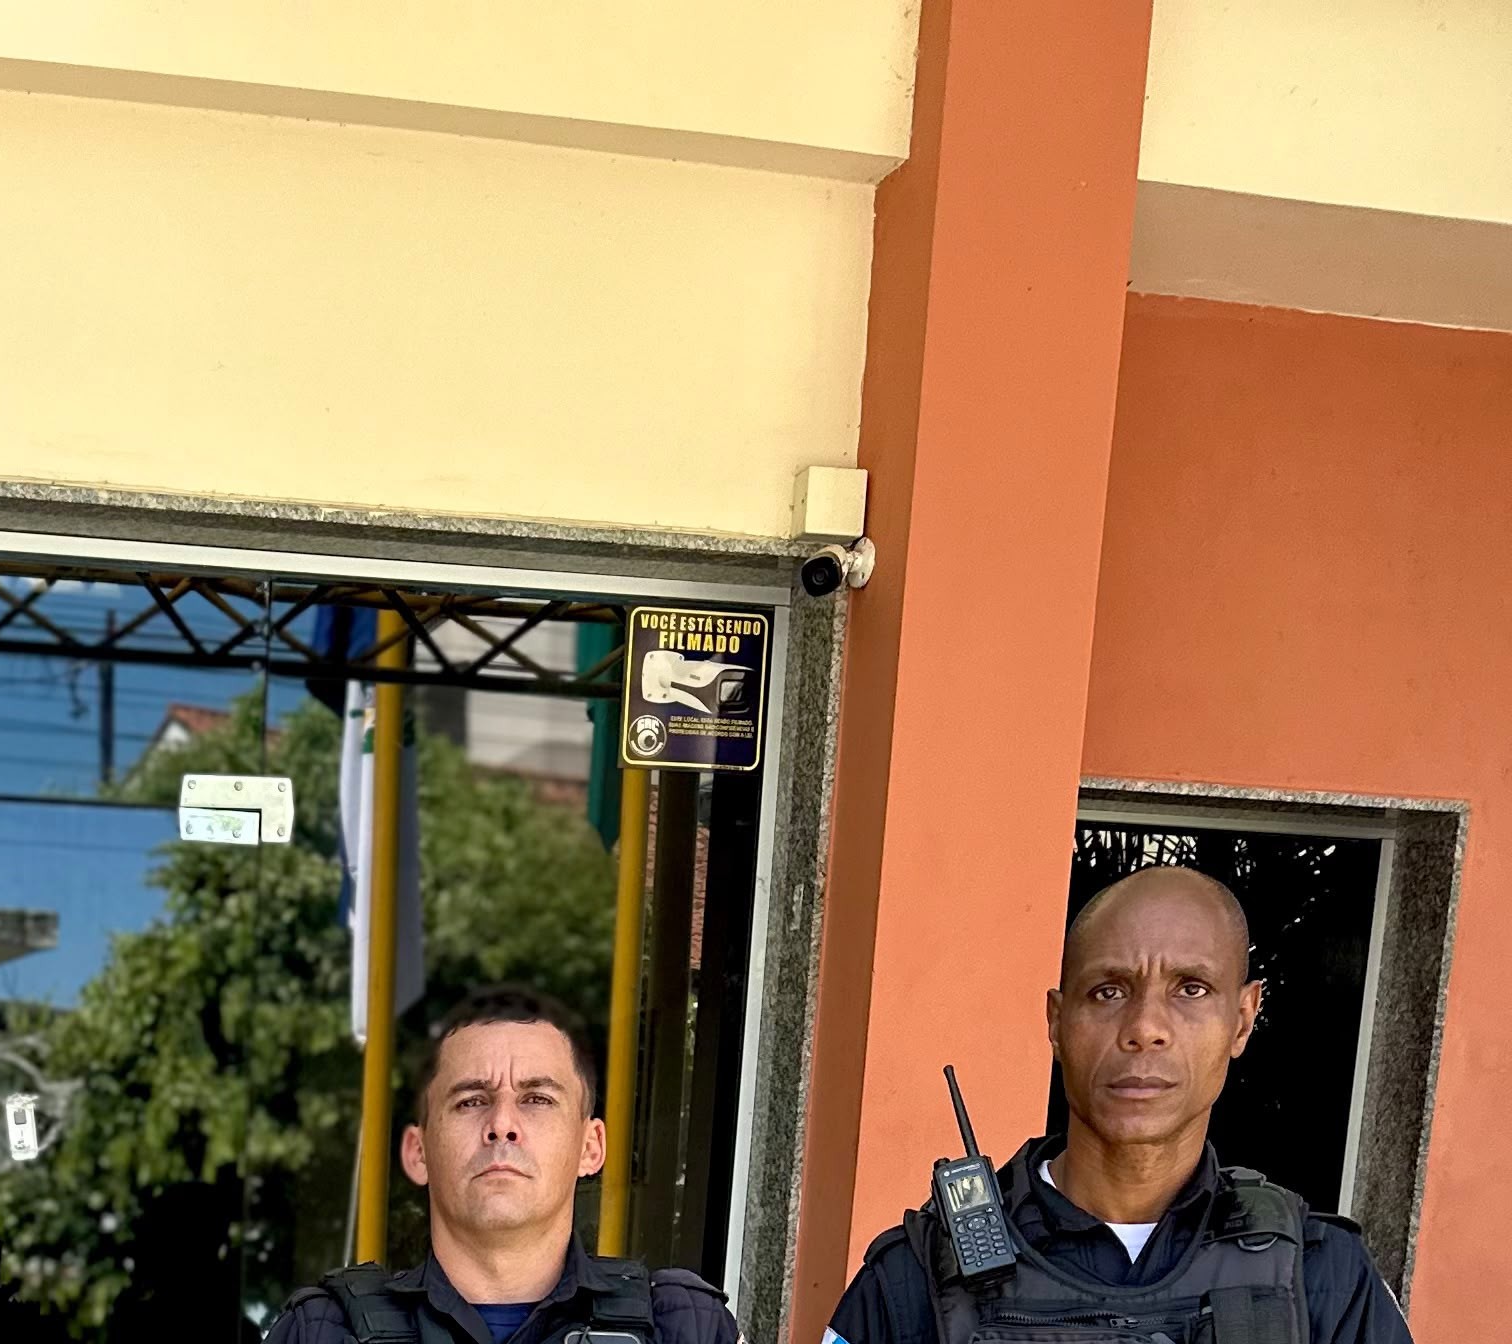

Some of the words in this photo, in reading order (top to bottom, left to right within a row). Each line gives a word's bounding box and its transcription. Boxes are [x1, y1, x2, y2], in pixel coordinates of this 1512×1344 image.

[641, 613, 676, 630] VOCÊ
[680, 616, 713, 633] ESTÁ
[716, 619, 761, 636] SENDO
[658, 631, 740, 654] FILMADO
